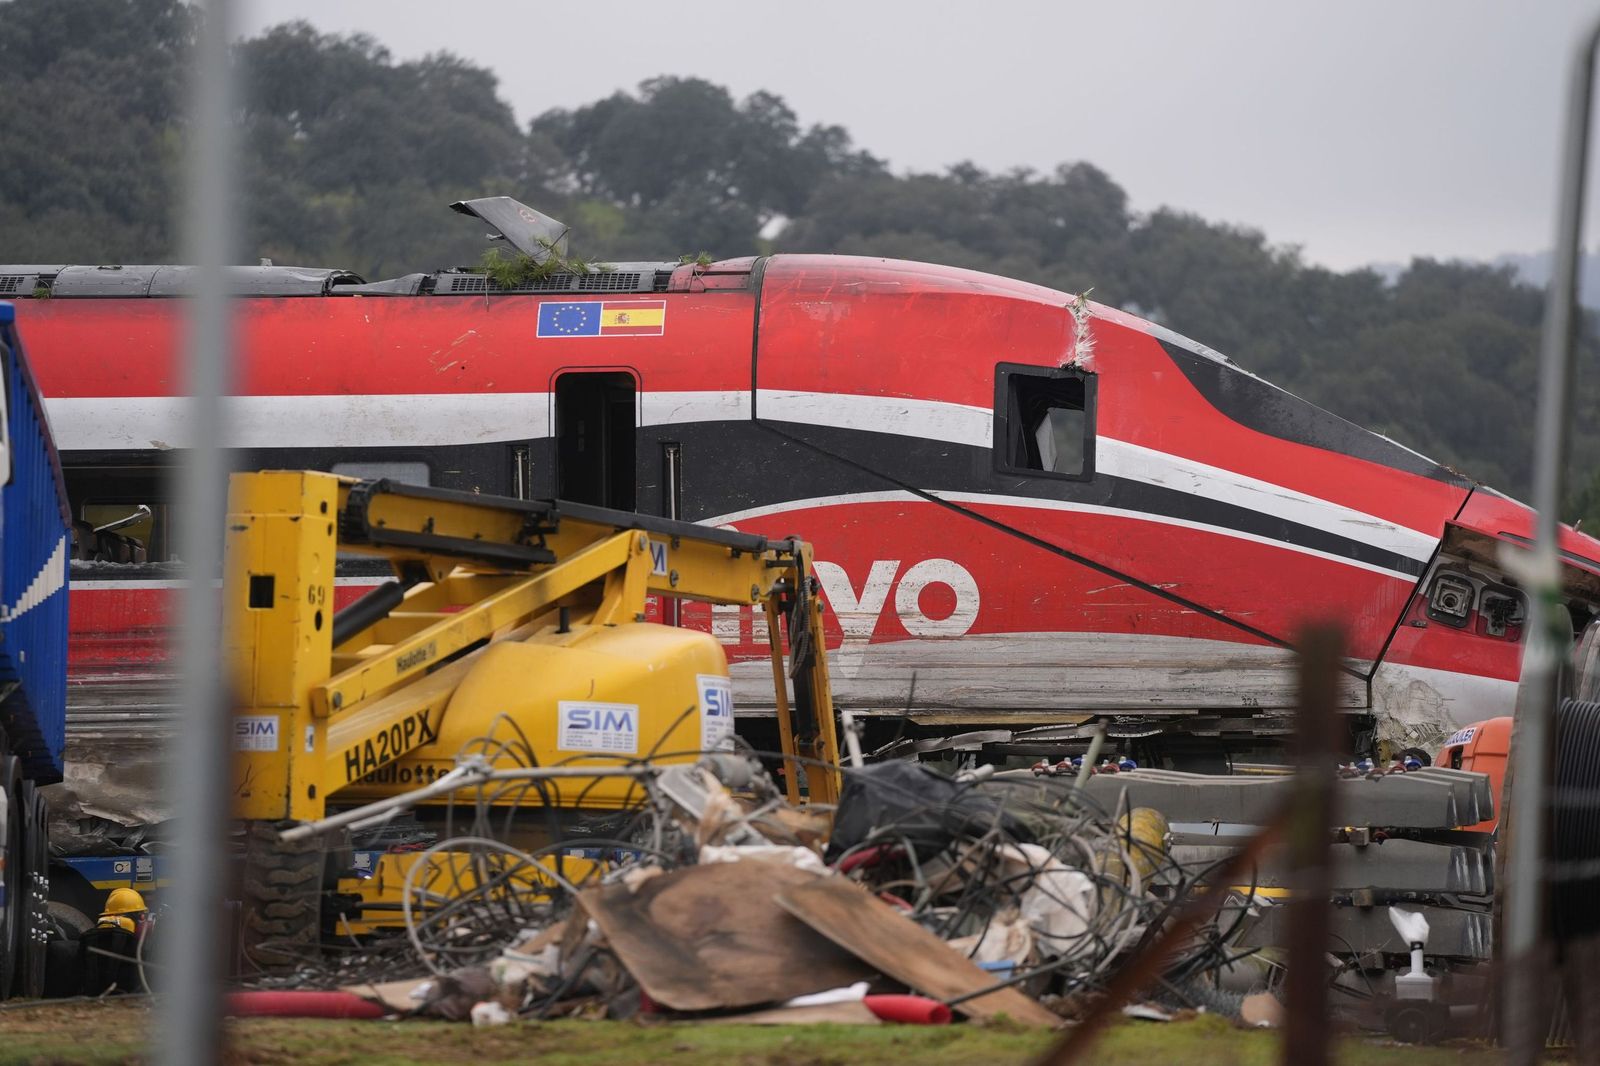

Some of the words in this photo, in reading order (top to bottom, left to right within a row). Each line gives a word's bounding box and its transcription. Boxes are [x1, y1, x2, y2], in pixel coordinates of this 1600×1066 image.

[308, 584, 325, 606] 69
[236, 721, 274, 735] SIM
[567, 709, 633, 732] SIM
[345, 708, 434, 782] HA20PX
